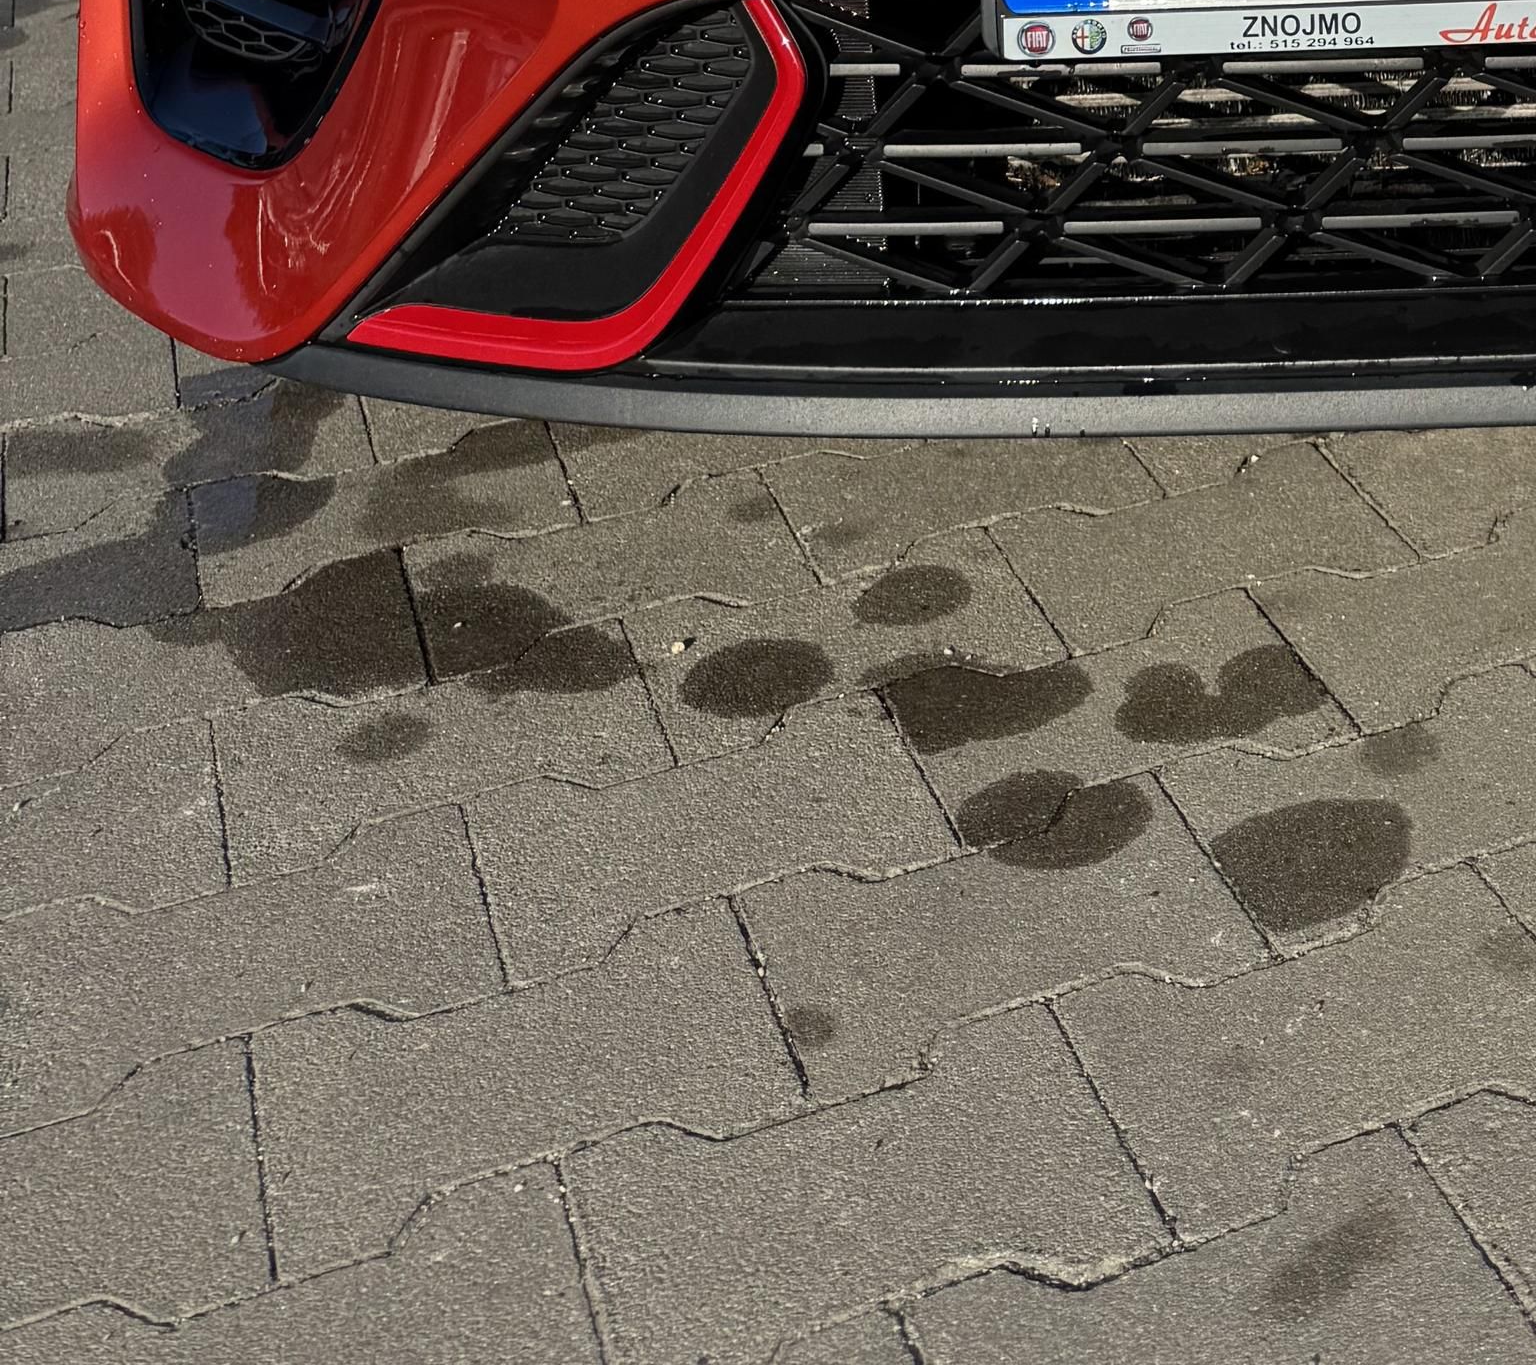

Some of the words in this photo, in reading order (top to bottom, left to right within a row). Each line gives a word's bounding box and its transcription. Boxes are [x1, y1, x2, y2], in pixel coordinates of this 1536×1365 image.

[1242, 12, 1362, 38] ZNOJMO
[1026, 30, 1049, 49] FIAT
[1230, 40, 1263, 50] tel.:
[1269, 38, 1301, 49] 515
[1306, 37, 1338, 47] 294
[1343, 36, 1375, 46] 964
